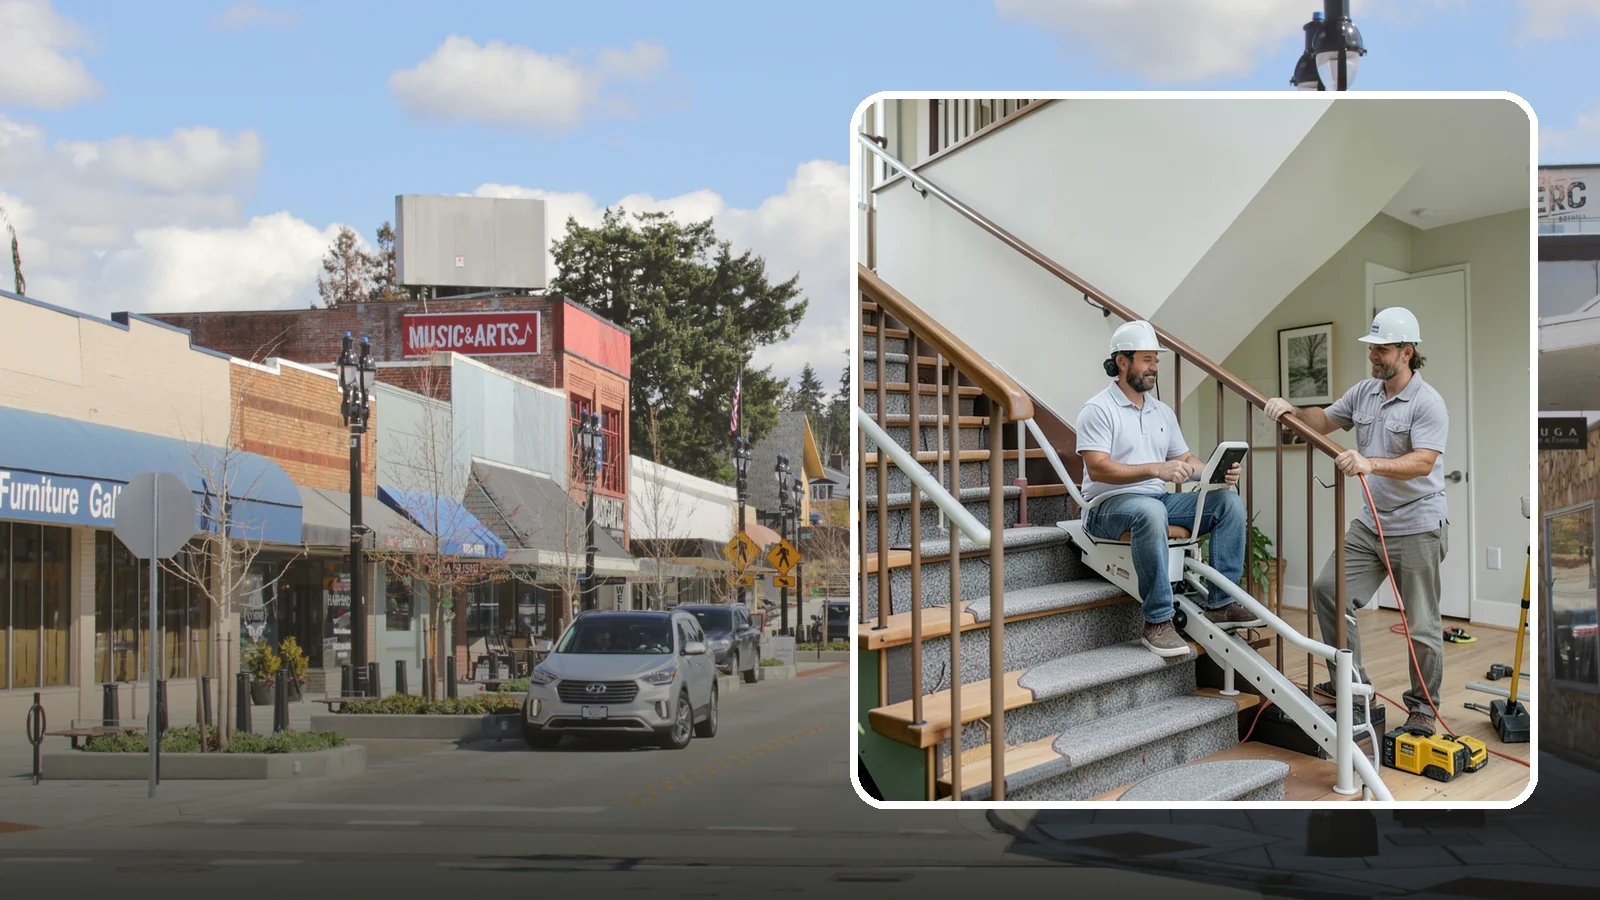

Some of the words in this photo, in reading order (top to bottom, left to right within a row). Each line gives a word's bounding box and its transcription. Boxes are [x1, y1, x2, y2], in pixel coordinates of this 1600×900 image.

[0, 471, 79, 515] Furniture
[89, 482, 122, 519] Gal
[453, 563, 479, 574] SUSHI
